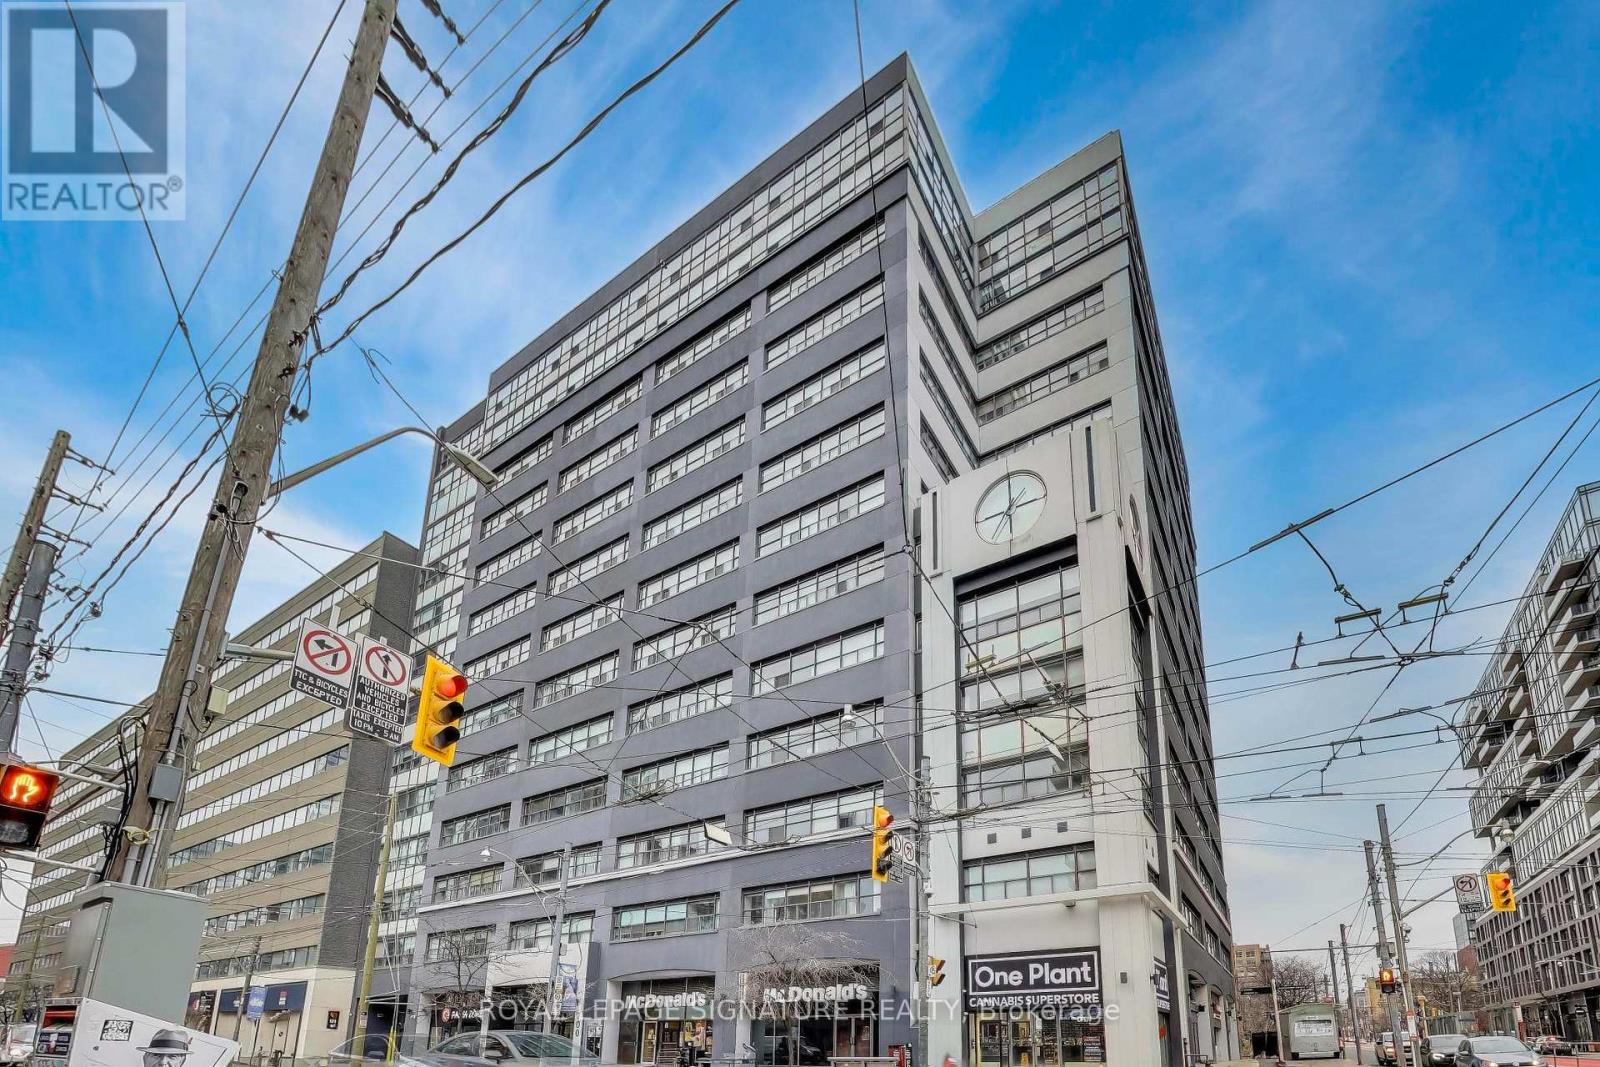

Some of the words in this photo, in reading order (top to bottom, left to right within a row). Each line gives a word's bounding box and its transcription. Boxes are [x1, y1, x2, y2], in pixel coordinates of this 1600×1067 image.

[294, 669, 308, 681] TTC
[315, 678, 349, 698] BICYCLES
[296, 681, 342, 705] EXCEPTED
[359, 676, 406, 701] AUTHORIZED
[356, 692, 372, 703] AND
[374, 699, 405, 717] BICYCLES
[364, 686, 400, 707] VEHICLES
[353, 709, 371, 722] TAXIS
[373, 716, 403, 734] EXCEPTED
[360, 701, 399, 722] EXCEPTED
[383, 729, 389, 737] 5
[389, 733, 399, 742] AM
[974, 966, 1024, 988] One
[1028, 961, 1093, 985] Plant
[624, 991, 706, 1009] McDonald's
[969, 995, 1025, 1008] CANNABIS
[1025, 993, 1100, 1005] SUPERSTORE
